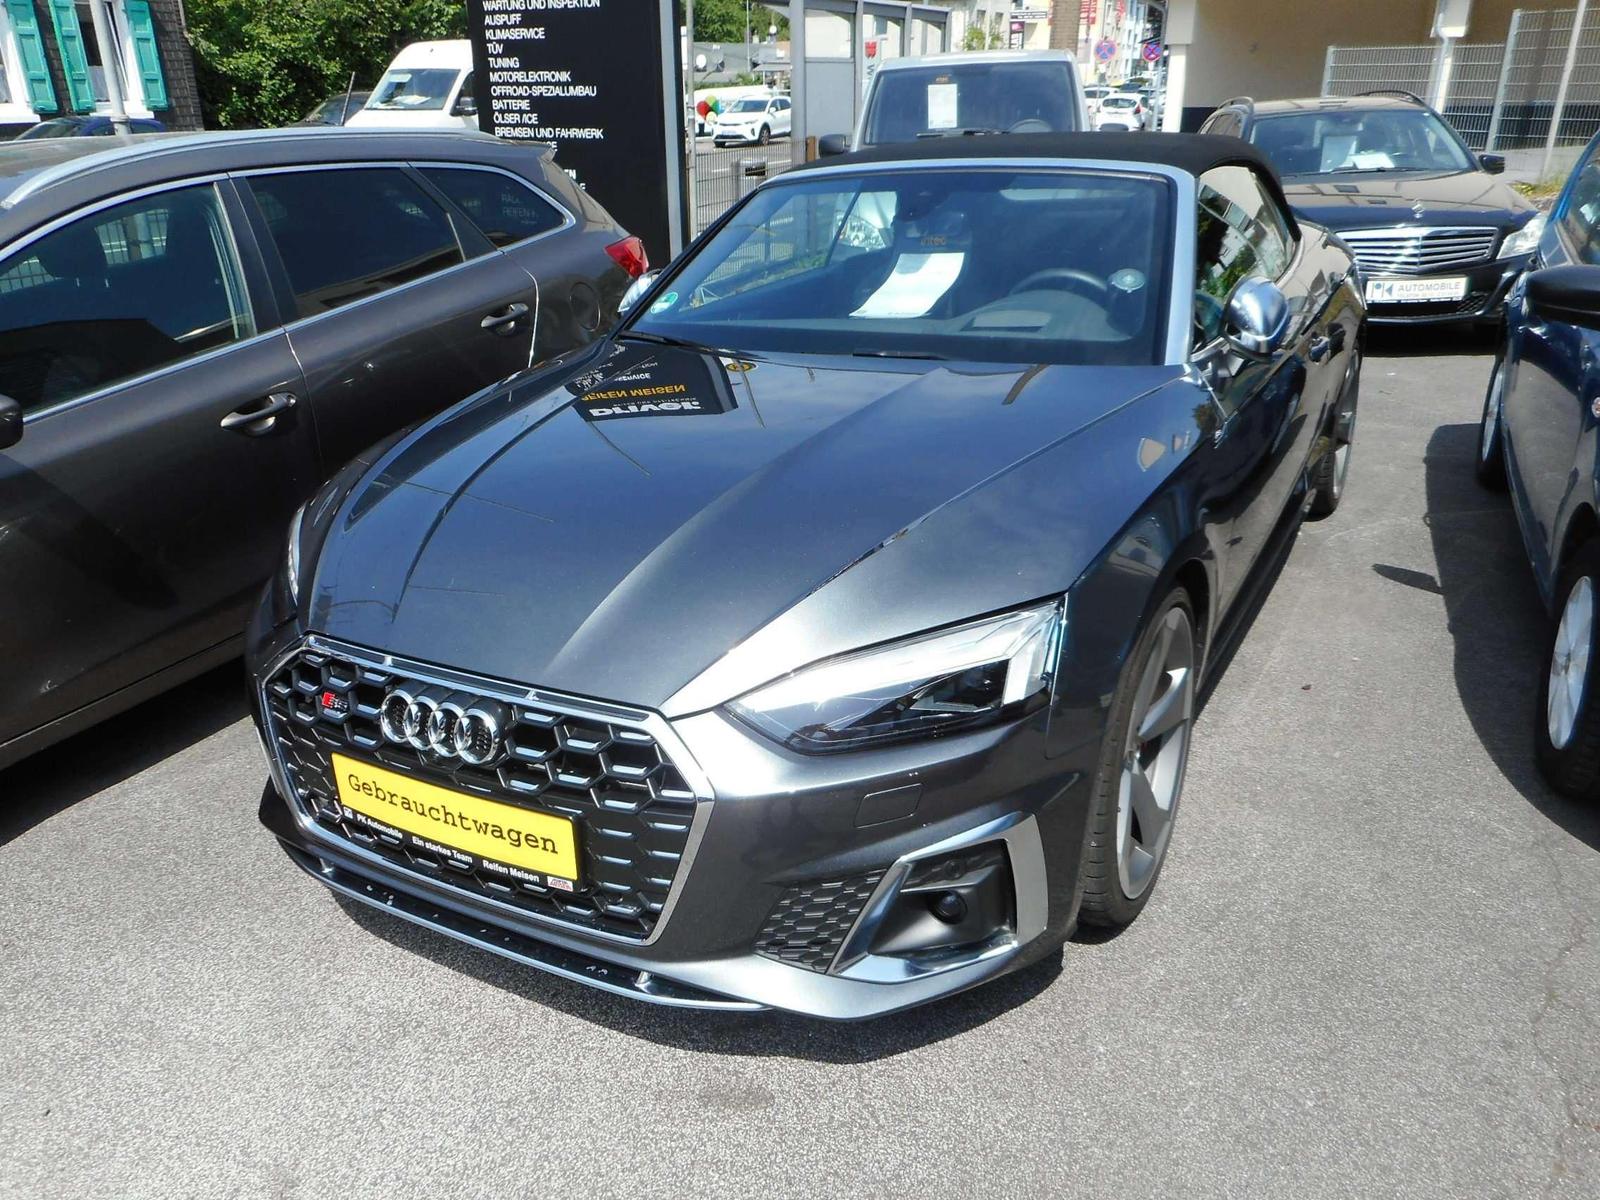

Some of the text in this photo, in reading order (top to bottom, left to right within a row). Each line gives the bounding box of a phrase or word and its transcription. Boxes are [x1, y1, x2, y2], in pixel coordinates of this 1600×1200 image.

[483, 0, 600, 11] WARTUNG UND INSPEKTION
[484, 14, 522, 25] AUSPUFF
[485, 27, 545, 40] KLIMASERVICE
[487, 43, 503, 55] TÜV
[488, 57, 519, 68] TUNING
[489, 71, 571, 83] MOTORELEKTRONIK
[491, 85, 597, 97] OFFROAD-SPEZIALUMBAU
[492, 99, 530, 111] BATTERIE
[495, 127, 604, 140] BREMSEN UND FAHRWERK
[1398, 282, 1461, 292] AUTOMOBILE
[347, 773, 558, 855] Gebrauchtwagen
[411, 835, 425, 847] Ein
[451, 849, 473, 864] Team
[482, 859, 509, 875] Reifen
